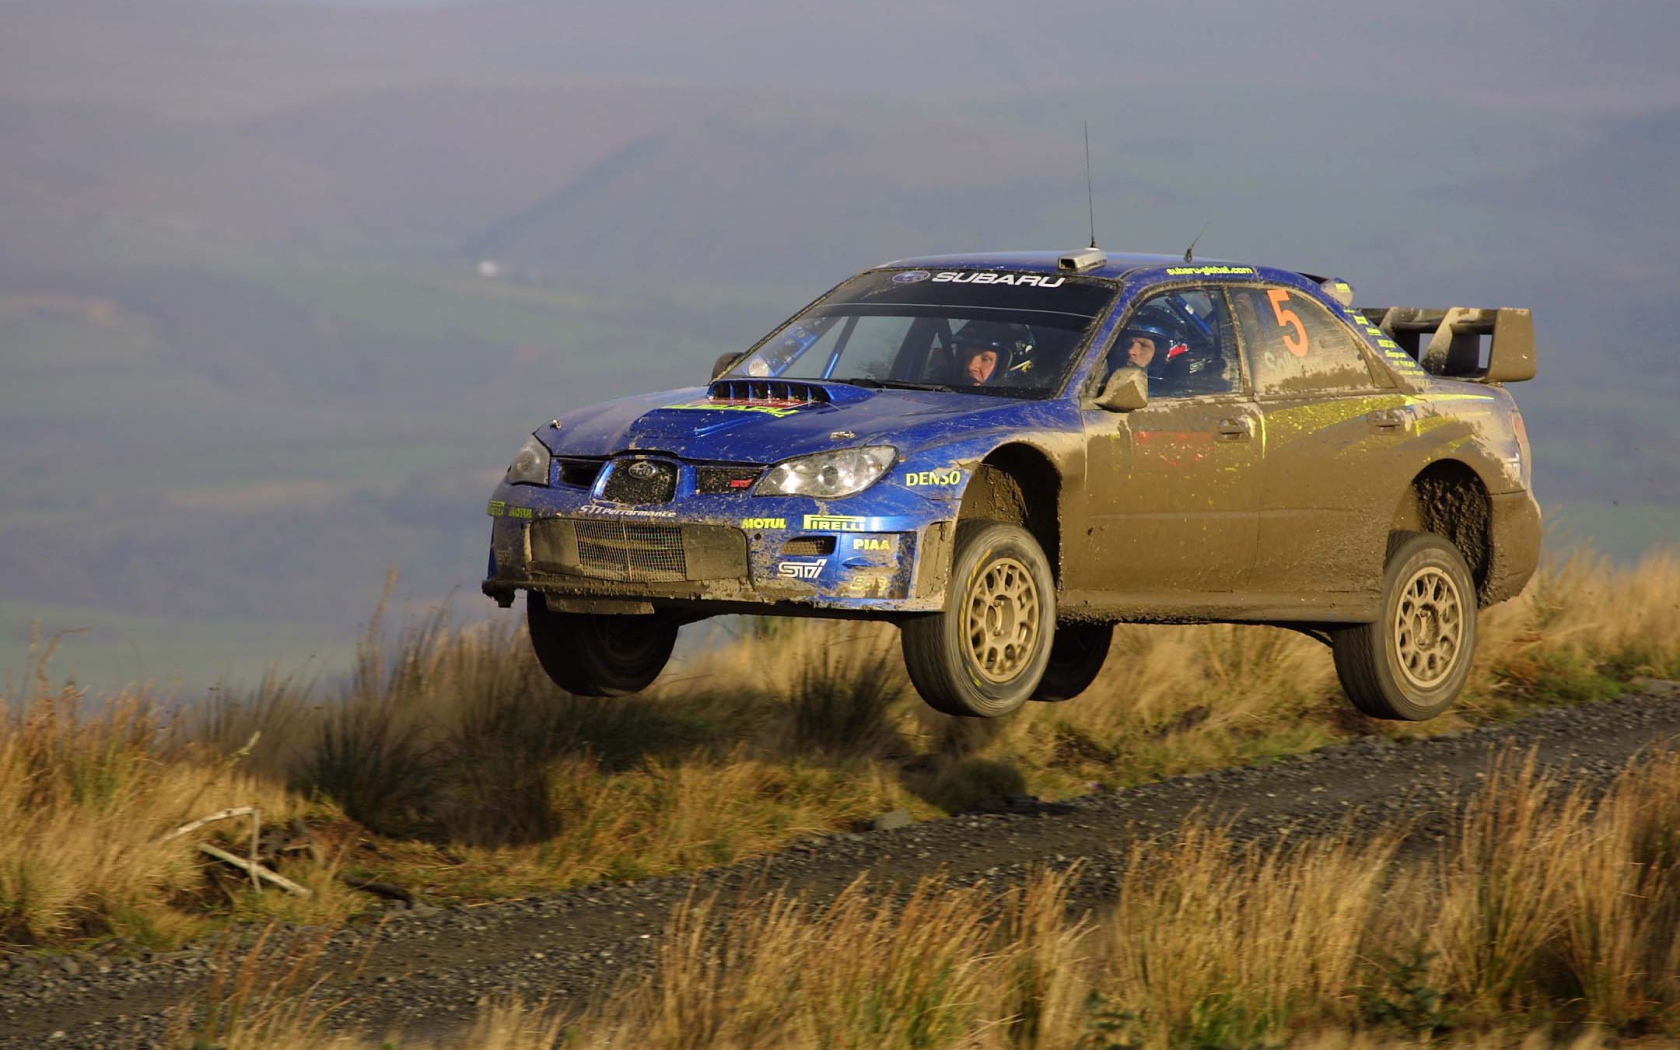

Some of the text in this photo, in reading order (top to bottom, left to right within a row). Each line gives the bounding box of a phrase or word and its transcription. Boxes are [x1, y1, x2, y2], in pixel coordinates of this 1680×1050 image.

[932, 271, 1065, 287] SUBARU
[1267, 289, 1309, 357] 5
[905, 471, 961, 487] DENSO
[741, 517, 787, 529] MOTUL
[803, 514, 866, 531] PIRELLI
[853, 538, 891, 550] PIAA
